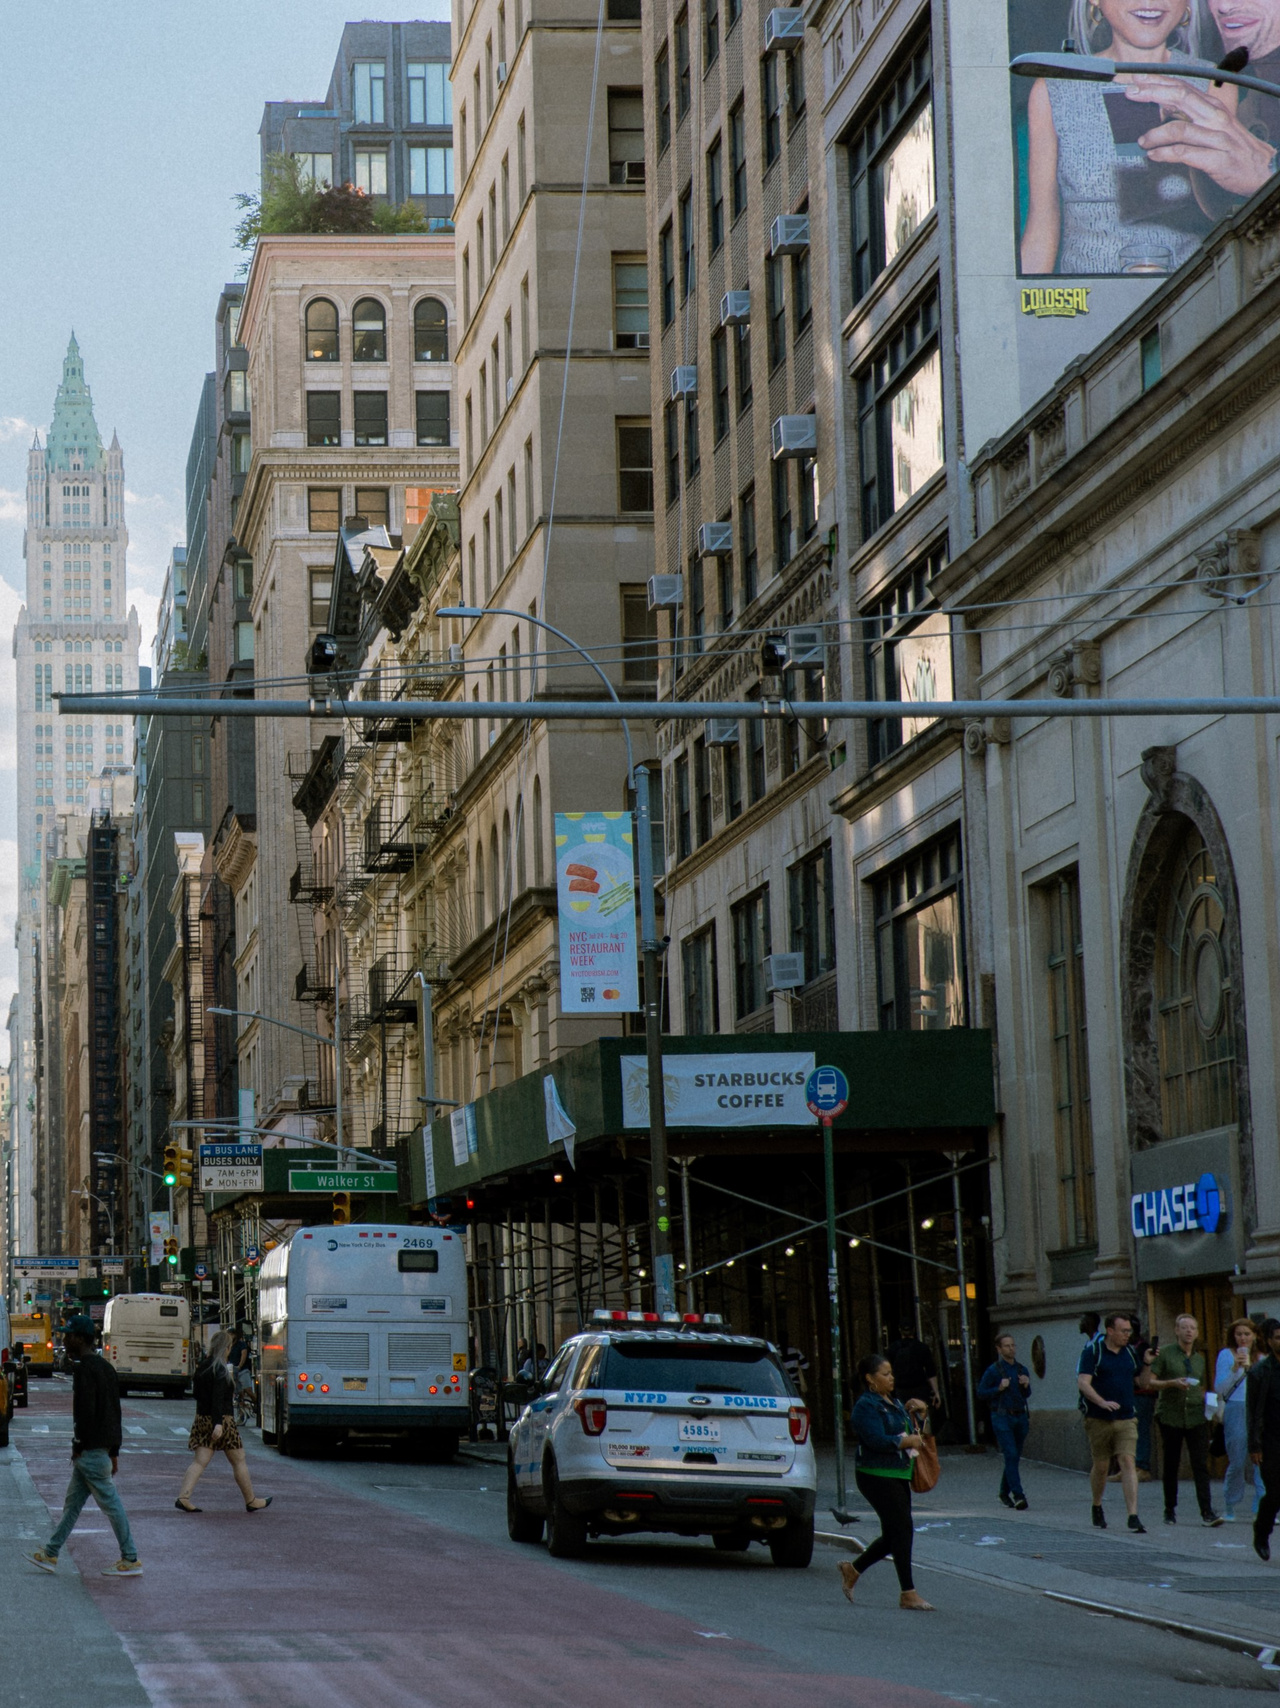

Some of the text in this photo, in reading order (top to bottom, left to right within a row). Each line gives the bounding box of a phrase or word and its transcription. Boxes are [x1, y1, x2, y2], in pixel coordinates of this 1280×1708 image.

[1021, 288, 1089, 313] COLOSSAL
[569, 931, 588, 942] NYC
[609, 932, 619, 940] Aug
[569, 942, 625, 955] RESTAURANT
[694, 1071, 805, 1087] STARBUCKS
[717, 1093, 784, 1109] COFFEE
[809, 1102, 818, 1112] NO
[214, 1145, 259, 1154] BUS LANE
[203, 1157, 258, 1165] BUSES ONLY
[317, 1175, 375, 1187] Walker St
[1131, 1183, 1198, 1238] CHASE
[403, 1238, 433, 1248] 2469
[624, 1392, 667, 1404] NYPD
[723, 1395, 777, 1409] POLICE
[683, 1424, 709, 1436] 4585
[608, 1443, 629, 1451] $10,000
